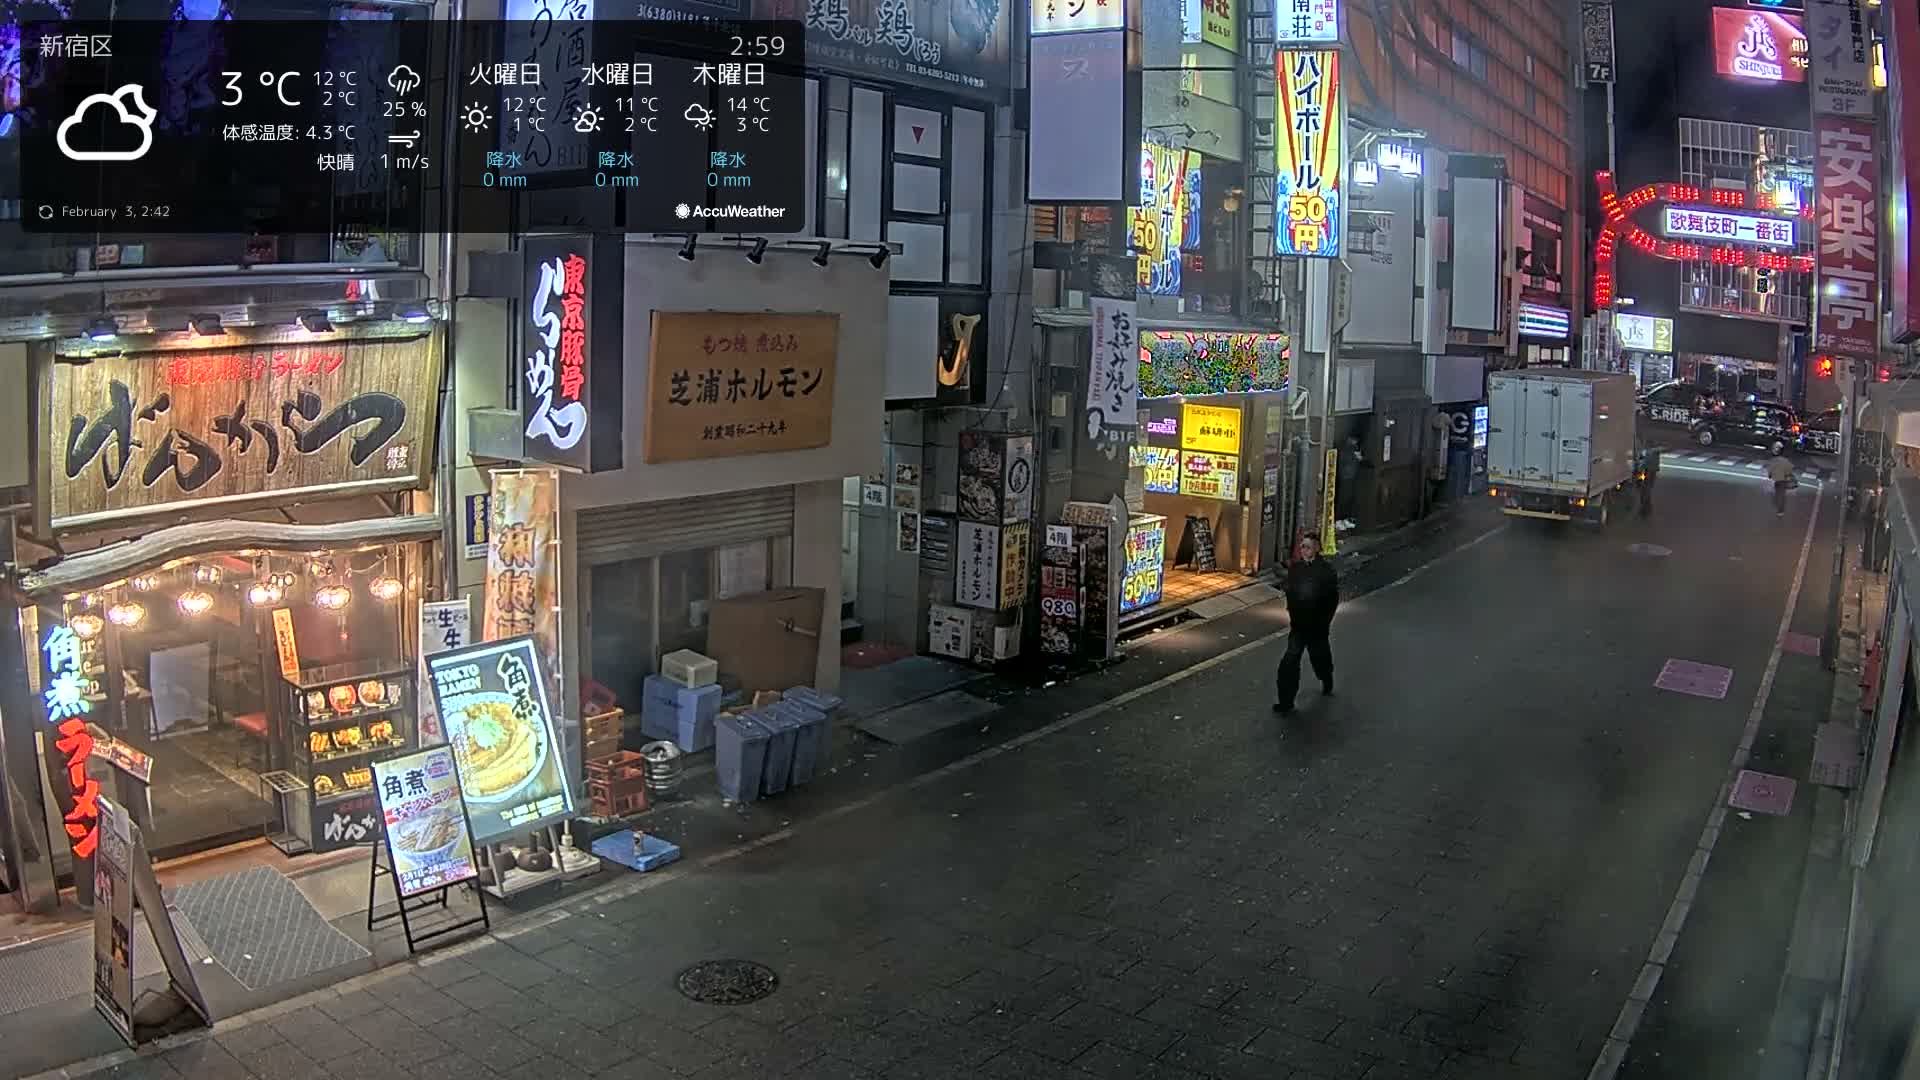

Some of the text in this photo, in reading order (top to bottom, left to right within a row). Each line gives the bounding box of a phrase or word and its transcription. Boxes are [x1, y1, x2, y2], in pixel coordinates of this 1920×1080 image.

[1590, 64, 1610, 80] 7F
[1294, 55, 1321, 191] ハイボール
[1289, 194, 1327, 220] 50
[1134, 219, 1157, 251] 50
[1294, 224, 1322, 254] 円
[1670, 211, 1790, 243] 歌舞伎町一番街
[1820, 127, 1876, 331] 安楽亭
[560, 252, 588, 402] 東京豚骨
[1818, 334, 1836, 348] 2F
[703, 332, 799, 355] もつ焼 煮込み
[669, 366, 825, 407] 芝浦ホルモン
[1651, 408, 1689, 424] S.RIDE
[1049, 531, 1069, 546] 4階
[973, 527, 984, 601] 芝浦ホルモン
[1042, 598, 1076, 617] 980
[436, 663, 480, 685] TOKYO
[438, 676, 482, 697] RAMEN
[500, 653, 538, 718] 角煮
[42, 624, 101, 859] 角煮ラーメン
[382, 769, 428, 801] 角煮
[323, 811, 377, 842] ばんか
